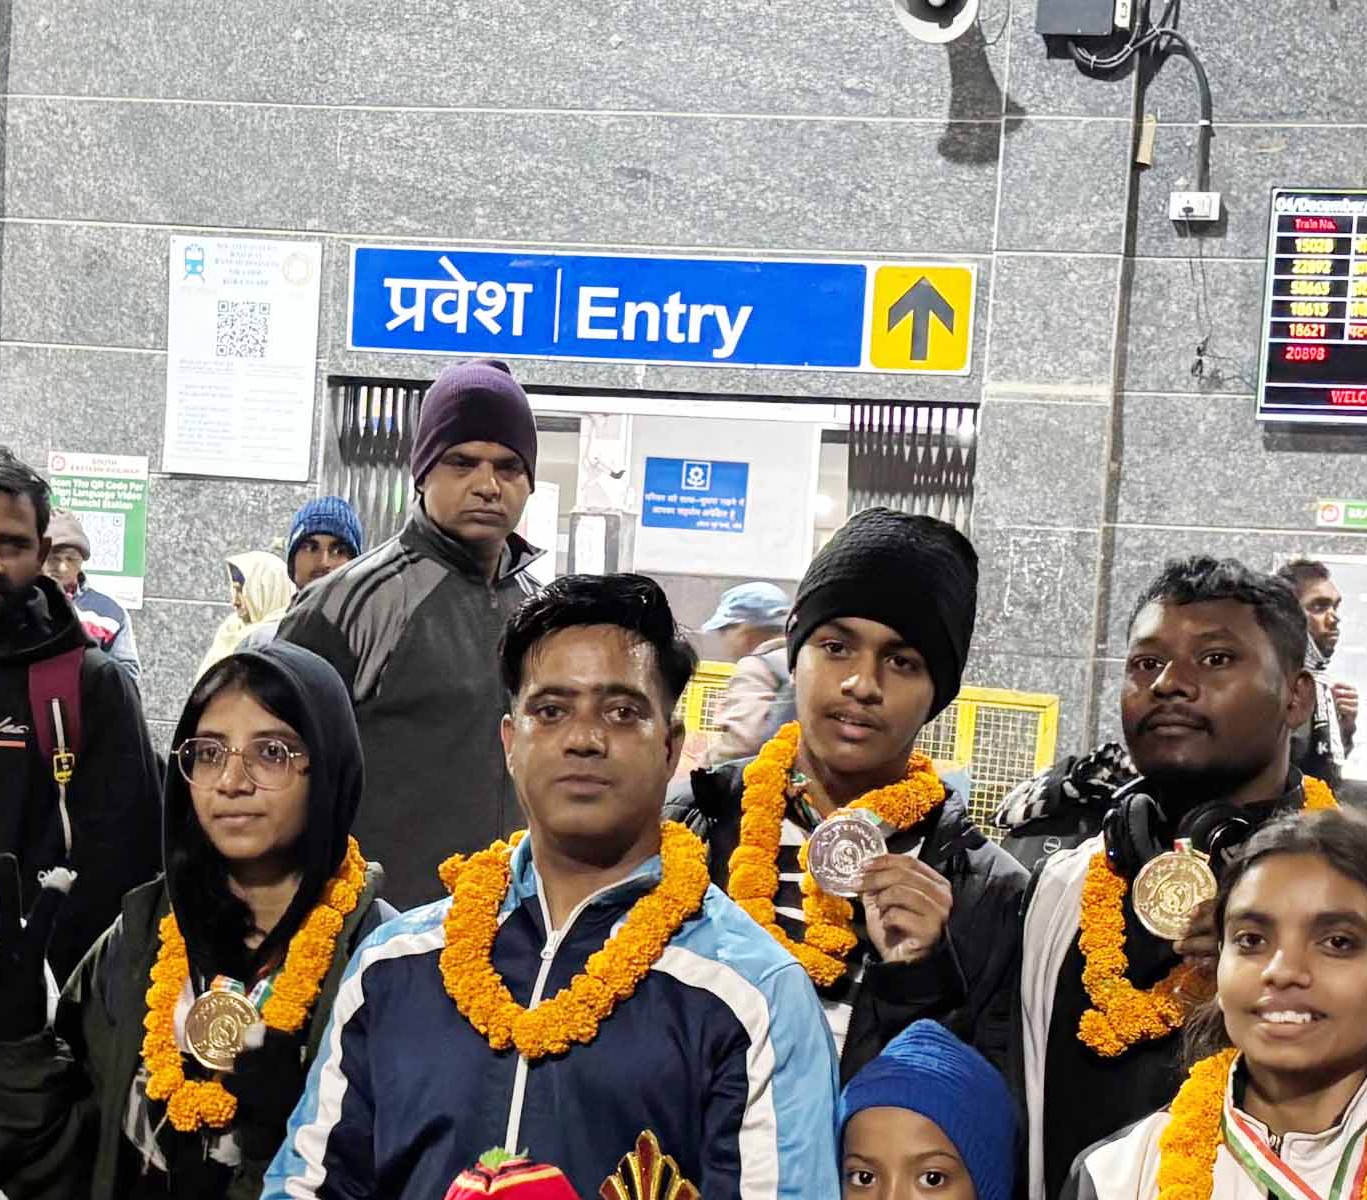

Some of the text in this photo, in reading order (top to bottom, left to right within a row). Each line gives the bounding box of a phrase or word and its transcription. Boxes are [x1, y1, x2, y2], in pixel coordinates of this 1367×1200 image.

[383, 256, 533, 336] प्रवेश
[577, 286, 753, 359] Entry
[1289, 323, 1326, 337] 18621
[1285, 347, 1326, 361] 20898
